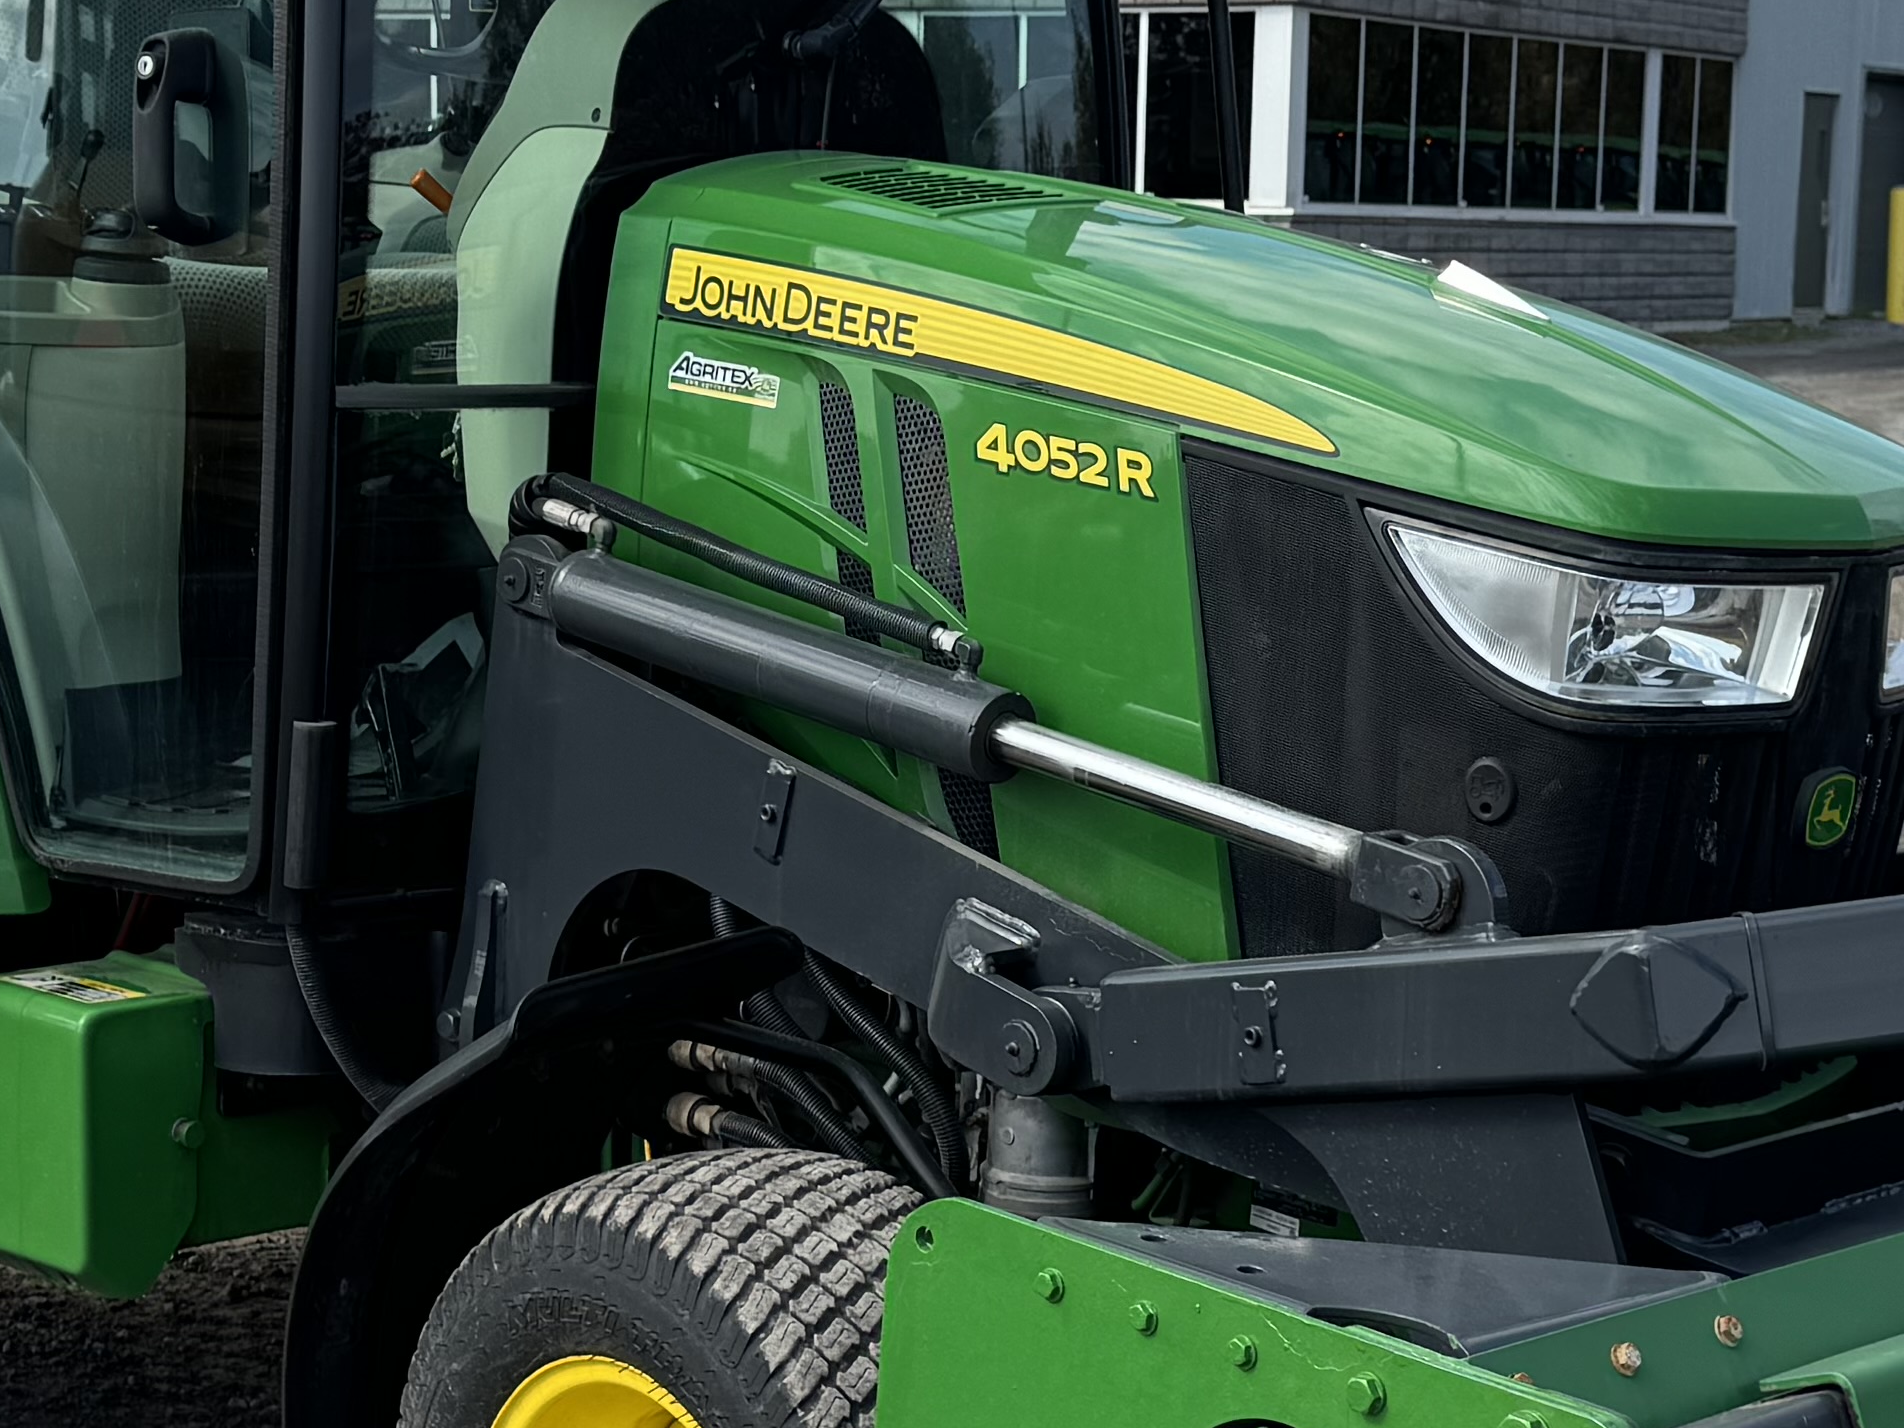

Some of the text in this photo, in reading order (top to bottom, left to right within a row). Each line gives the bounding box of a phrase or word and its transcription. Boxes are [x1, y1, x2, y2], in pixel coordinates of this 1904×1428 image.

[679, 265, 919, 351] JOHN DEERE
[673, 355, 755, 388] AGRITEX
